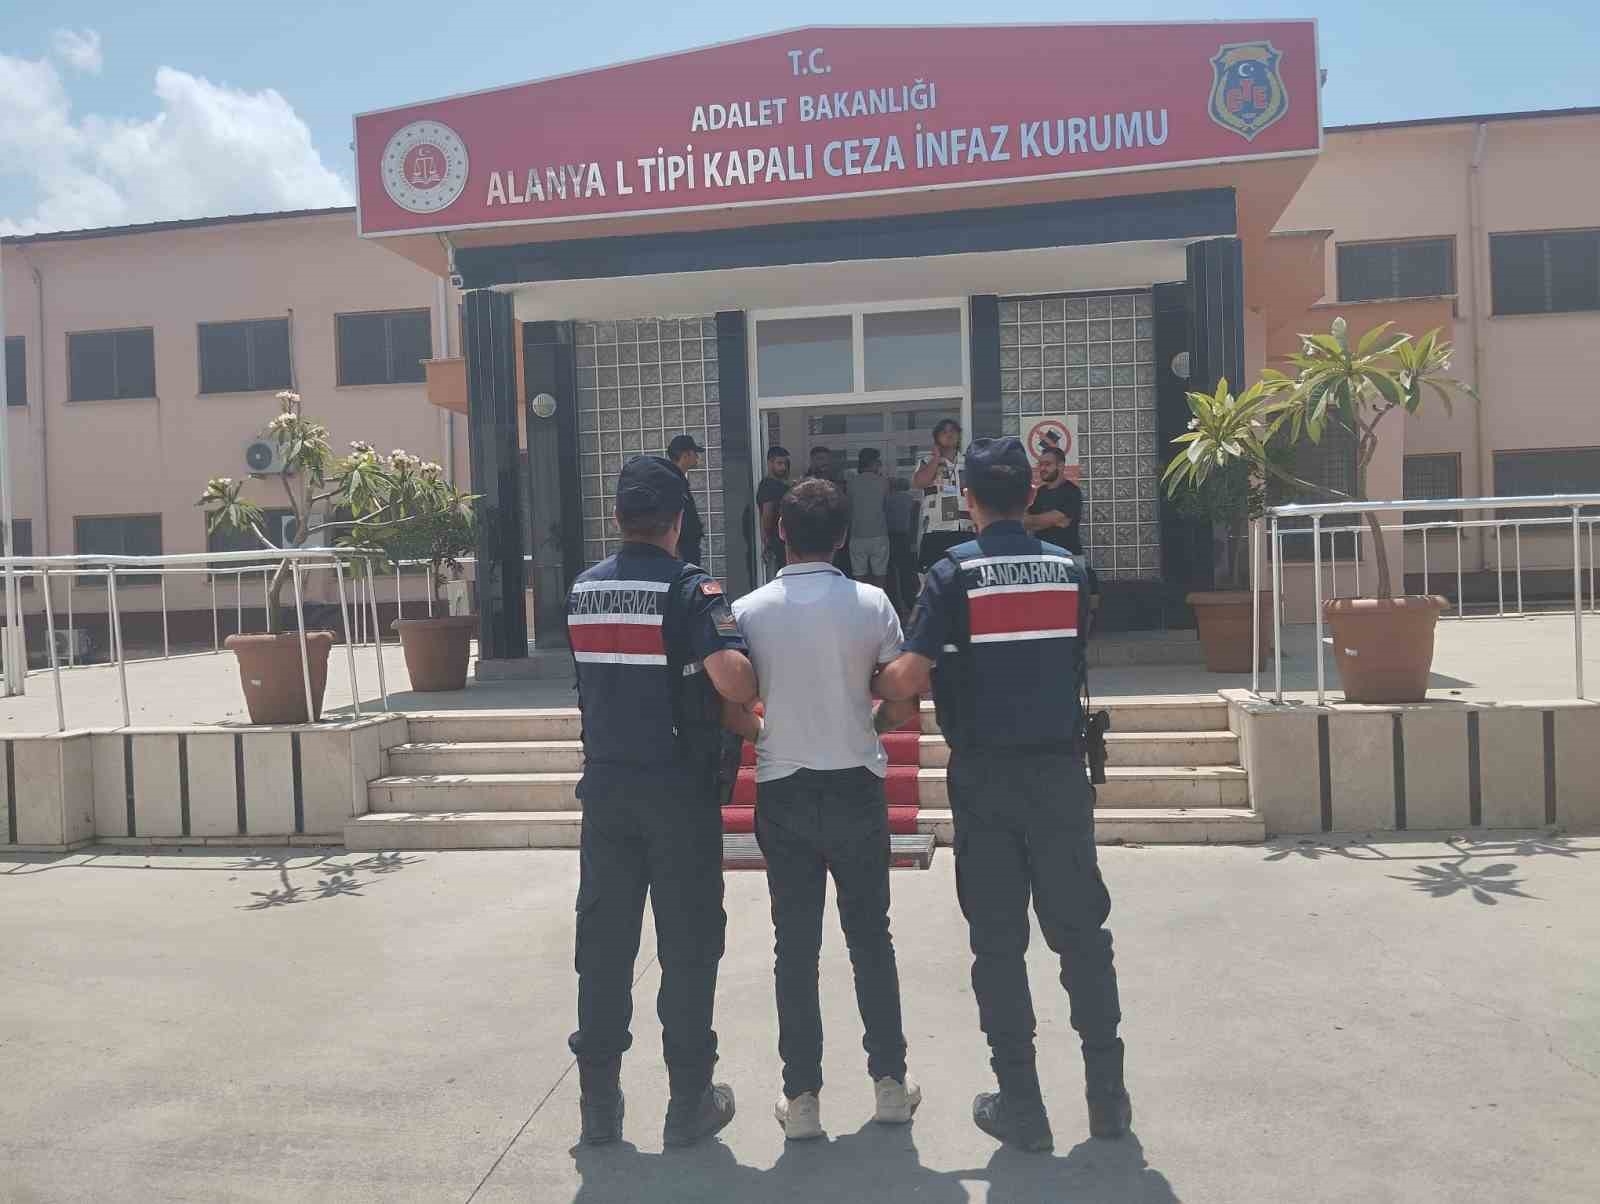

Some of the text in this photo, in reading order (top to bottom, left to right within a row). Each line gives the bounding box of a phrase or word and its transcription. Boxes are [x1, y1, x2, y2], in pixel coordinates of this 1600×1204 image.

[788, 48, 831, 75] T.C.
[691, 78, 936, 132] ADALET BAKANLIĞI
[486, 162, 606, 206] ALANYA
[616, 161, 633, 195] L
[637, 144, 695, 193] TİPİ
[704, 144, 813, 188] KAPALI
[823, 135, 905, 177] CEZA
[916, 123, 1010, 169] İNFAZ
[1020, 109, 1168, 159] KURUMU
[977, 562, 1070, 587] JANDARMA
[572, 590, 658, 615] JANDARMA
